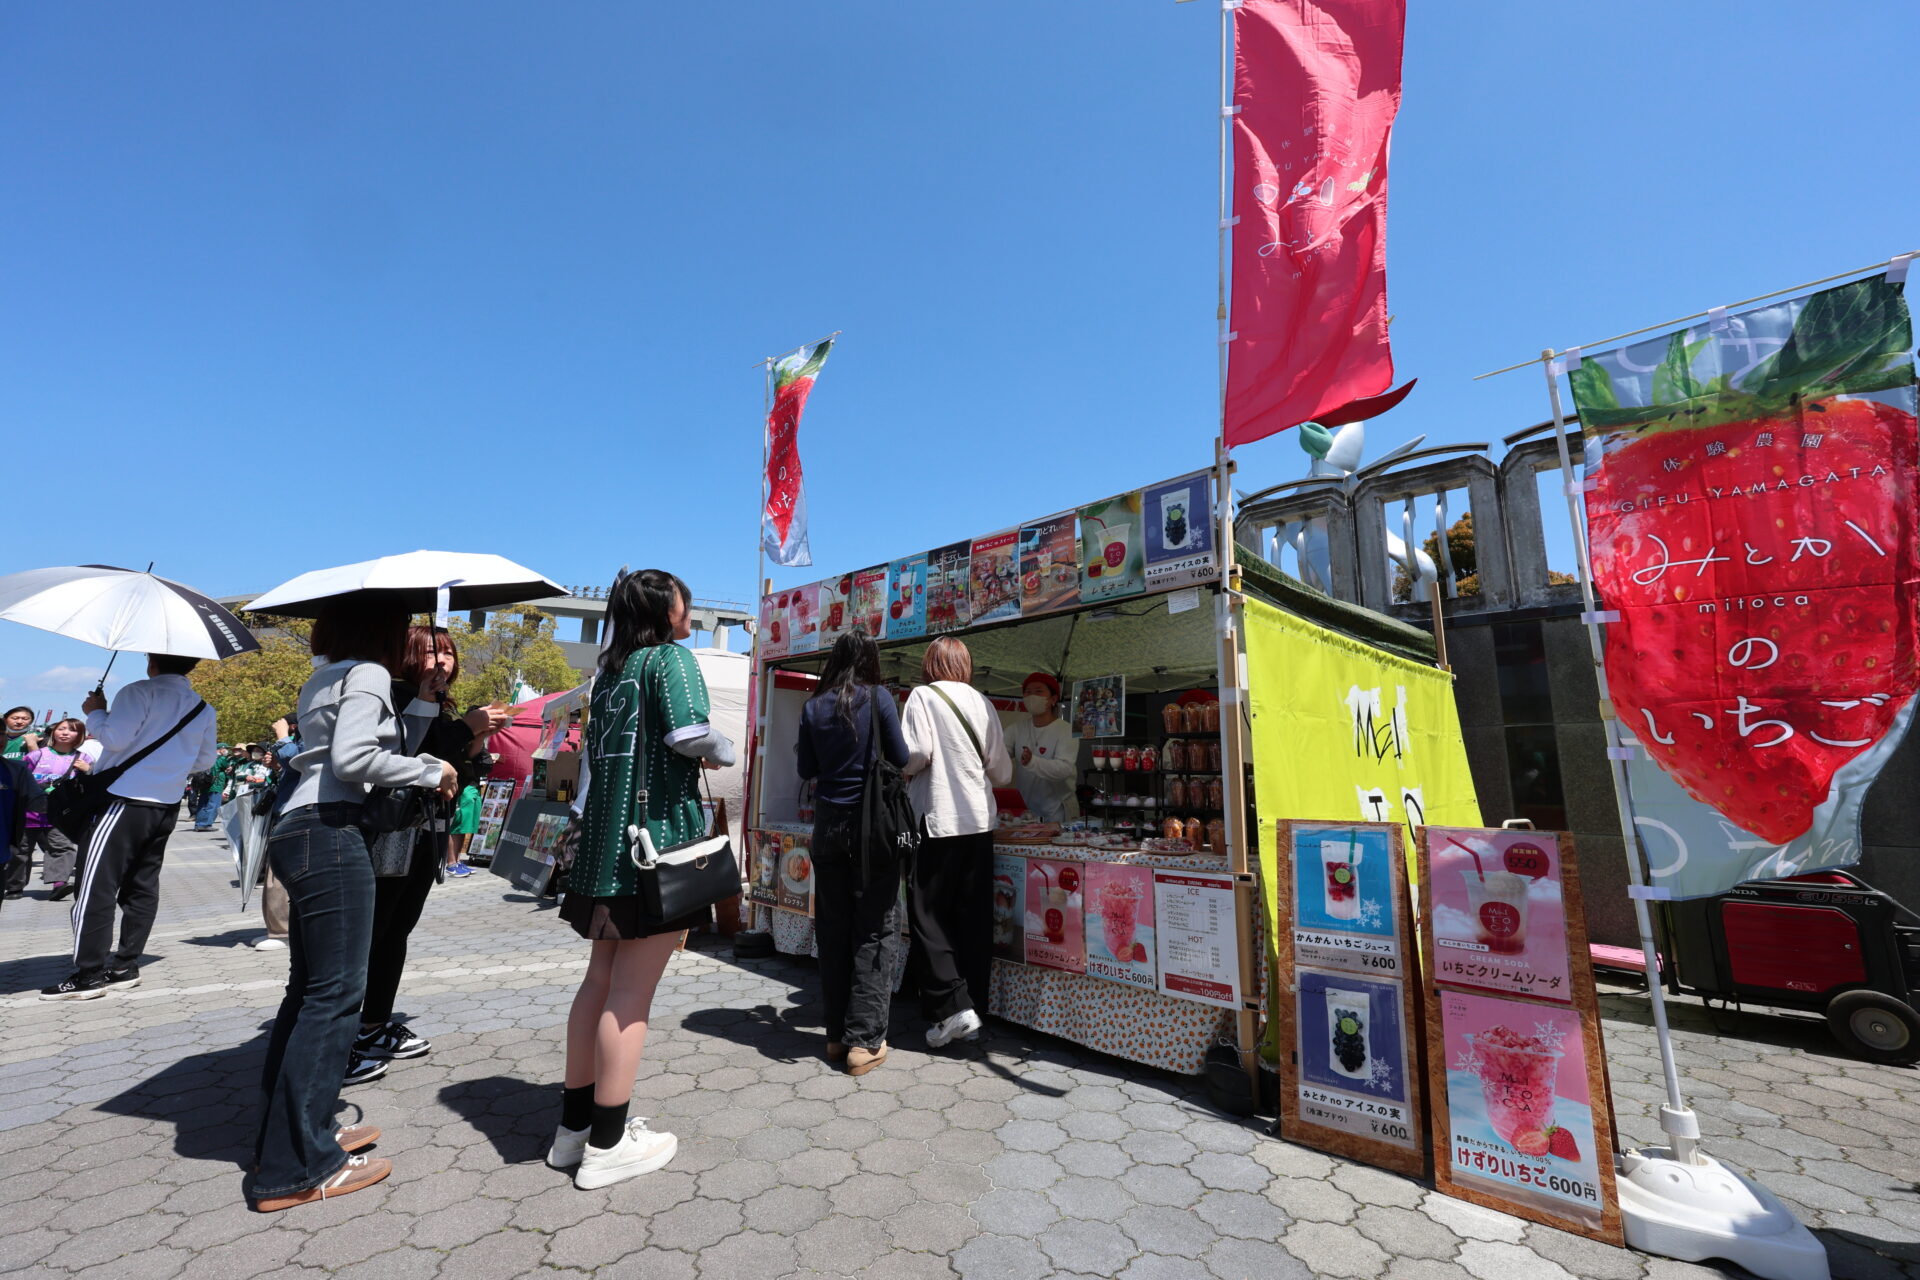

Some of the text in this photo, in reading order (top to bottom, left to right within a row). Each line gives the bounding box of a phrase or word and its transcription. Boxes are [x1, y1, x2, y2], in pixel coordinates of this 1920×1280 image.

[1663, 432, 1823, 473] 体験農園
[1620, 464, 1888, 513] GIFU YAMAGATA
[1632, 518, 1887, 586] みとか
[1091, 579, 1134, 596] レモネード
[1698, 594, 1809, 614] mitoca
[1728, 636, 1779, 670] の
[1641, 692, 1892, 750] いちご
[1187, 887, 1200, 896] ICE
[1187, 935, 1204, 944] HOT
[1296, 932, 1391, 952] かんかん いちご ジュース
[1089, 961, 1131, 981] けずりいちご
[1442, 961, 1562, 989] いちごクリームソーダ
[1470, 954, 1530, 969] CREAM SODA
[1303, 1089, 1402, 1120] みとか no アイスの実
[1457, 1146, 1548, 1189] けずりいちご
[1549, 1175, 1597, 1202] 600円
